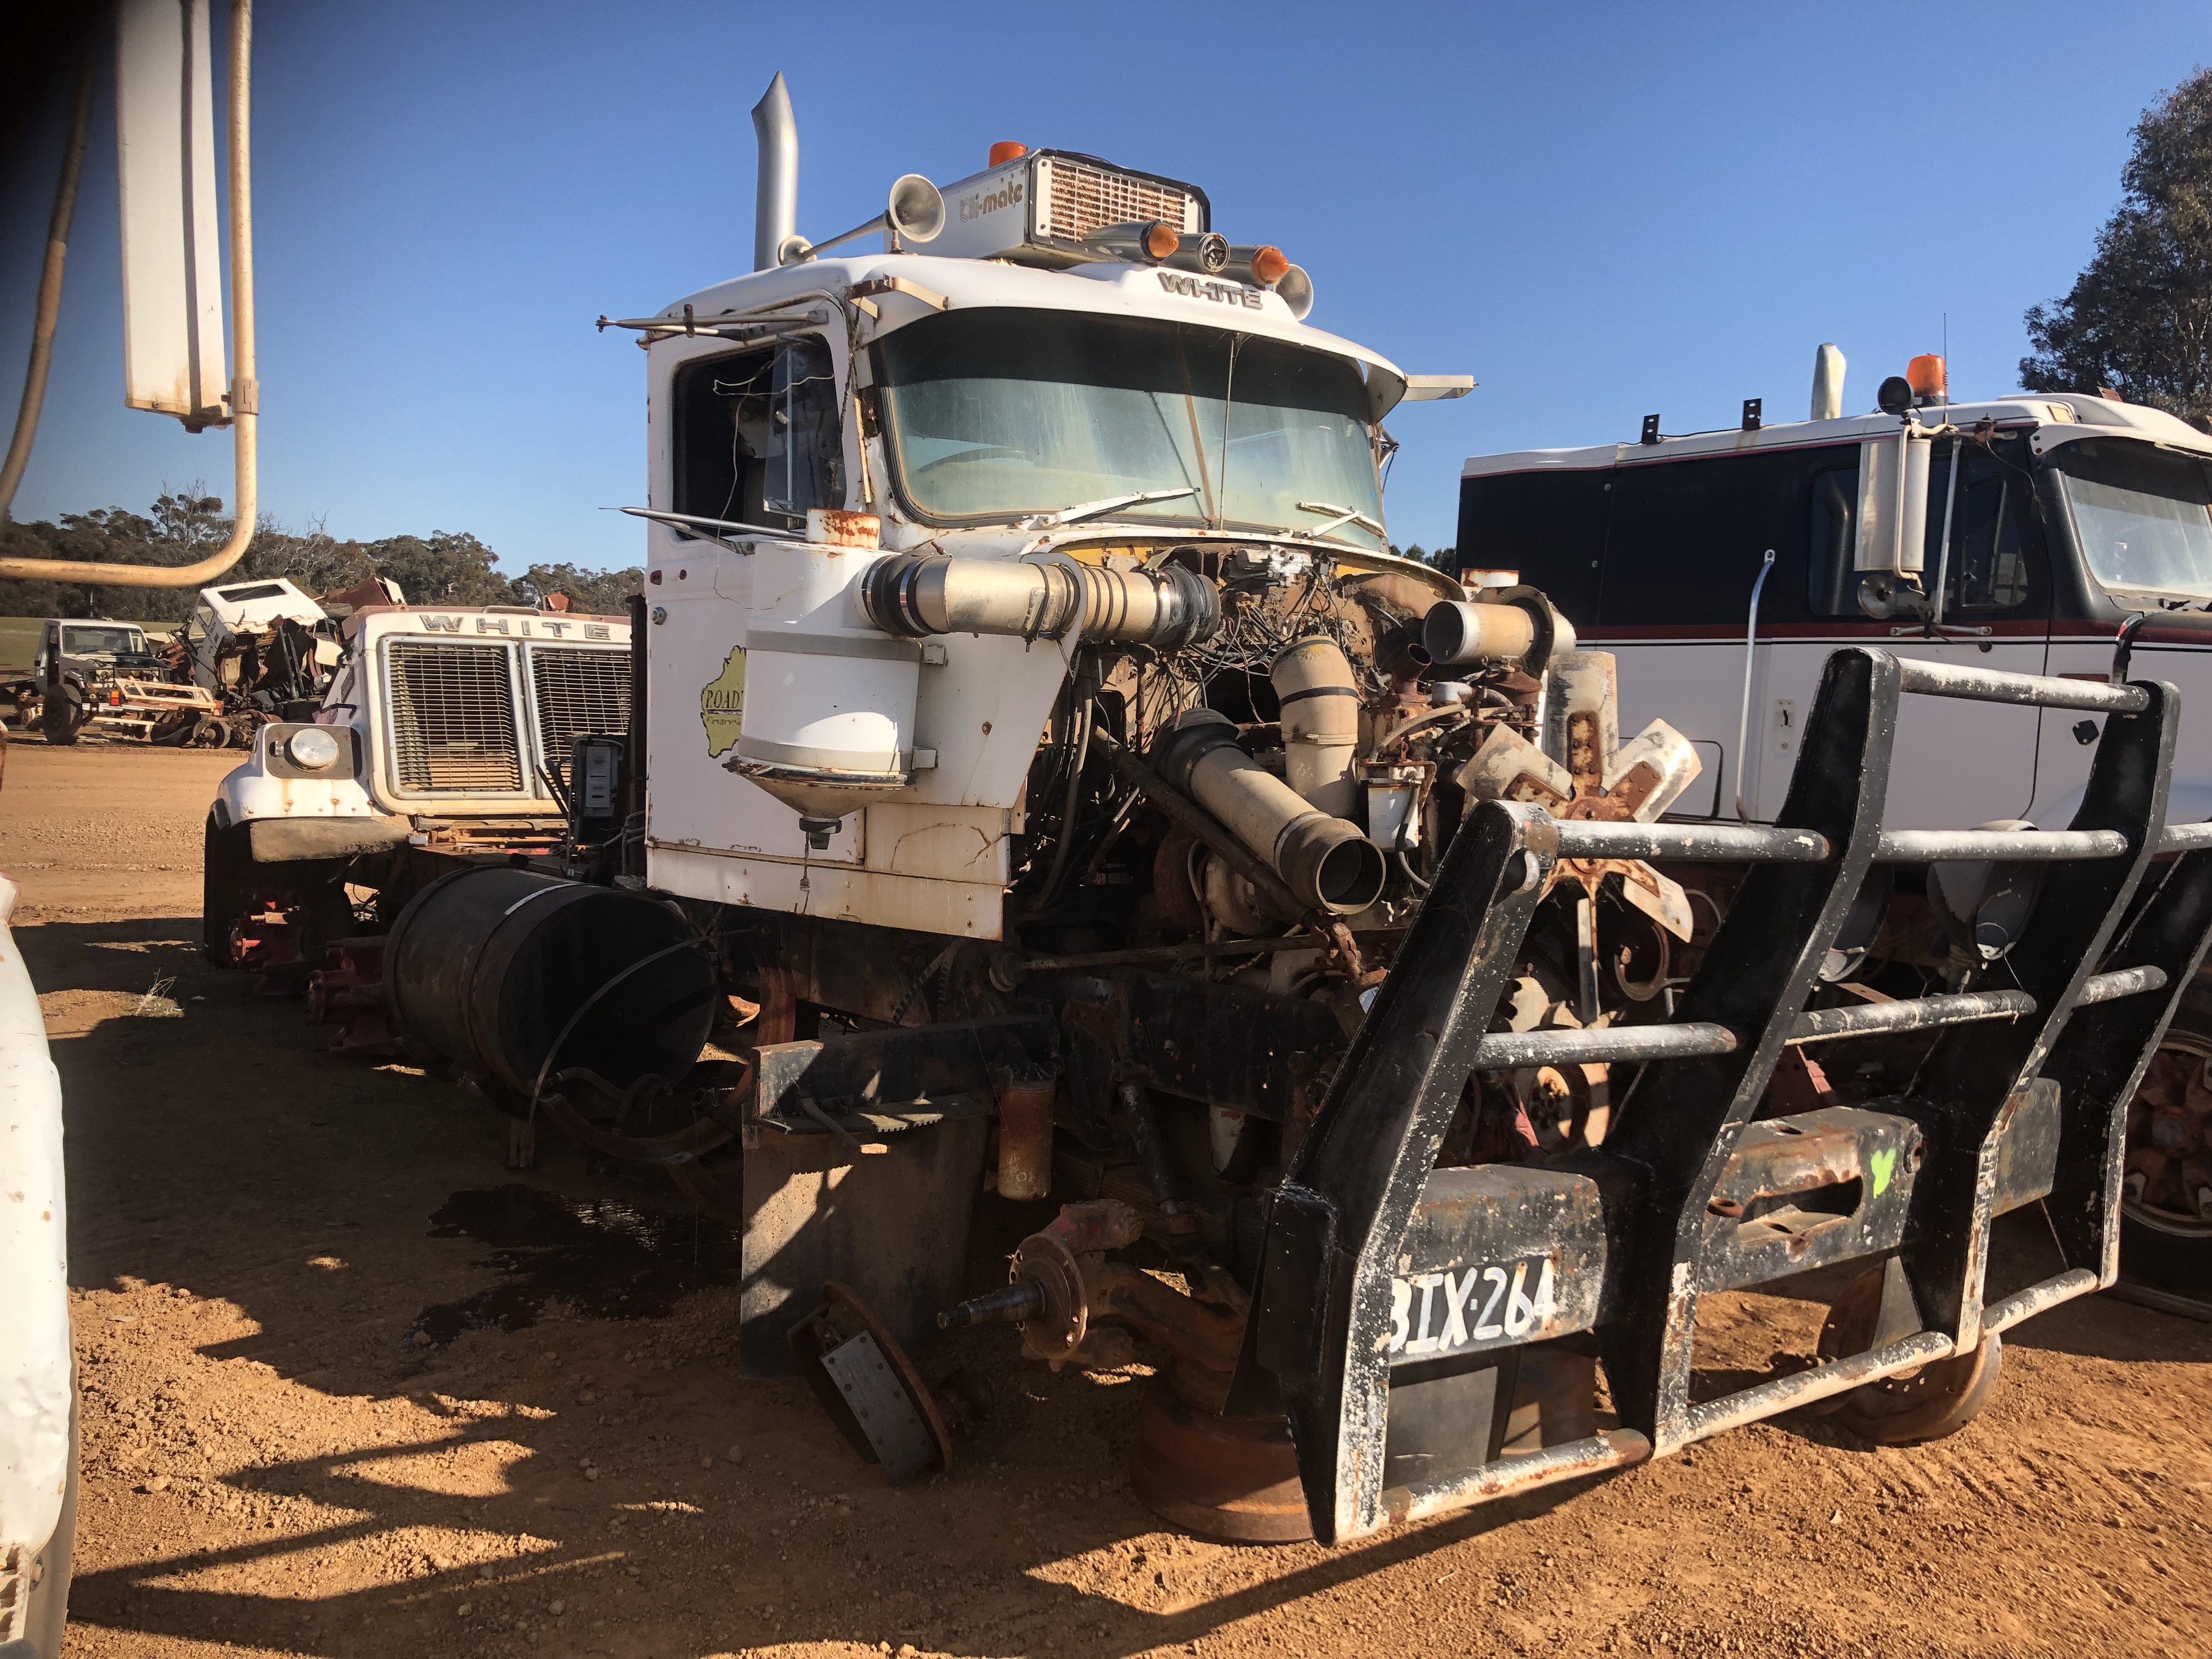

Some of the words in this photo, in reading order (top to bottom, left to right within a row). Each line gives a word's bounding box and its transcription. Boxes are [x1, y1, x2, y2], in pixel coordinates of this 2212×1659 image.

[1157, 272, 1263, 311] WHITE
[419, 614, 611, 641] WHITE
[706, 689, 744, 709] ROAD
